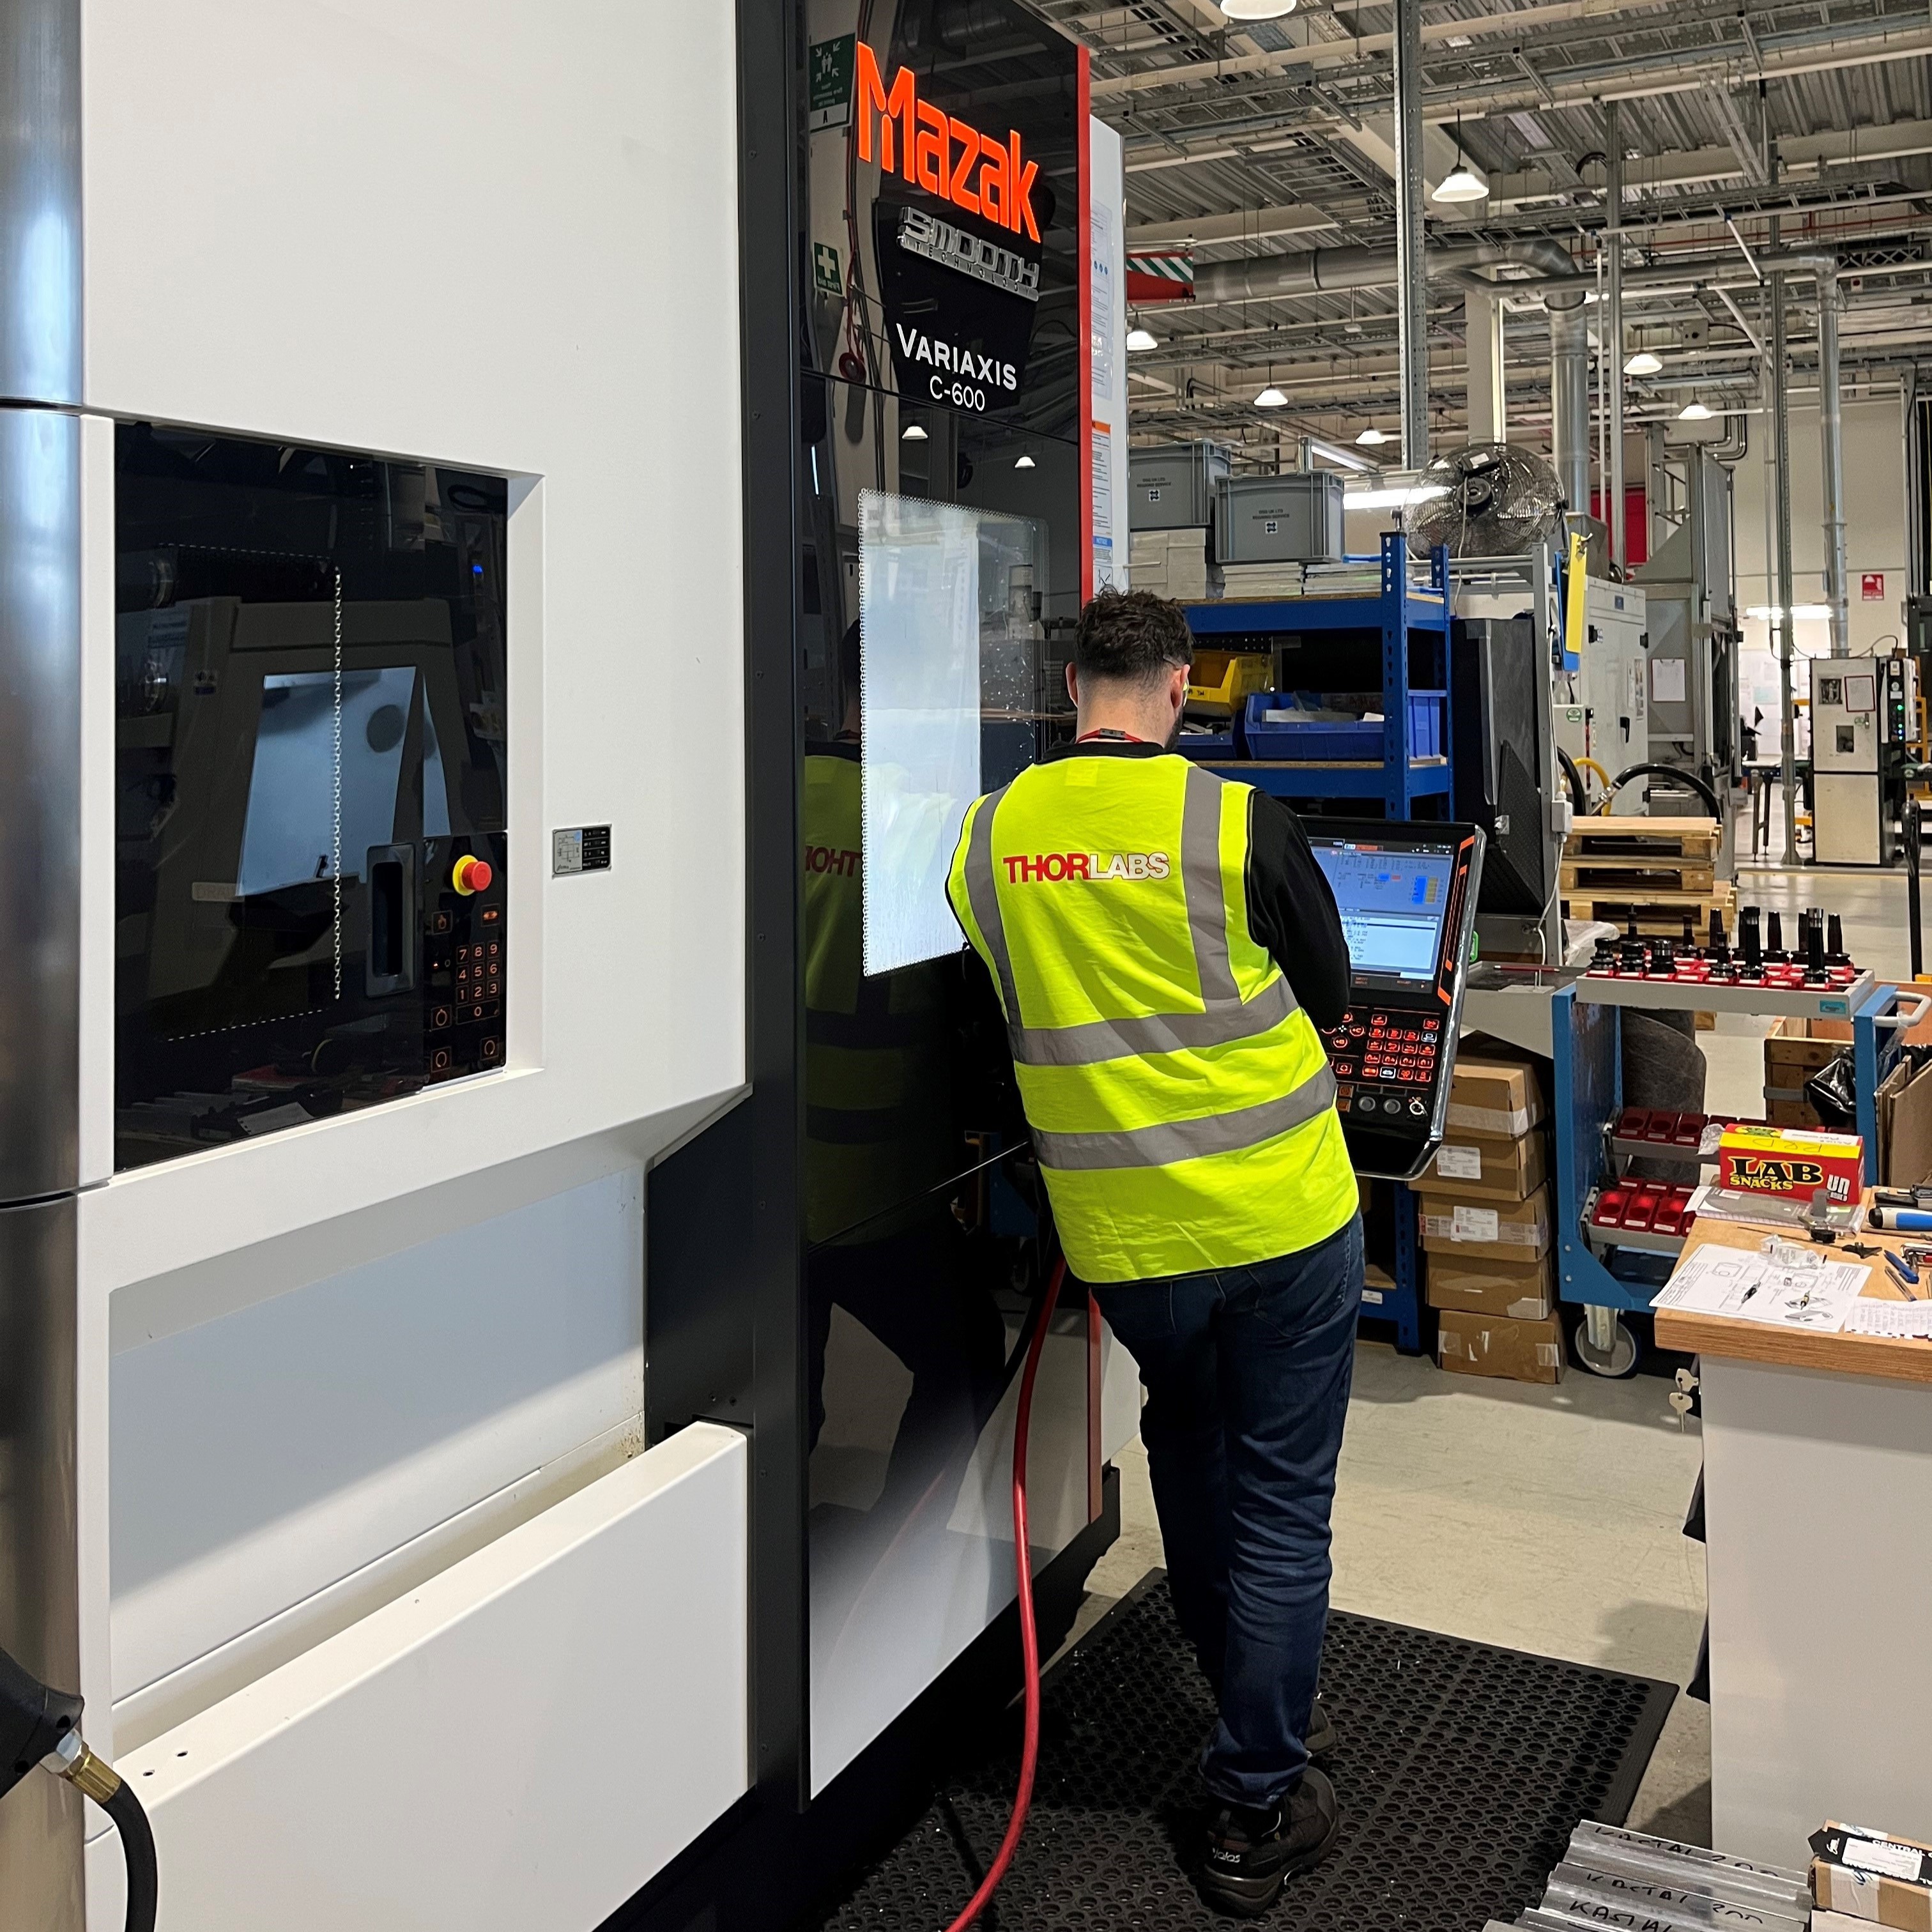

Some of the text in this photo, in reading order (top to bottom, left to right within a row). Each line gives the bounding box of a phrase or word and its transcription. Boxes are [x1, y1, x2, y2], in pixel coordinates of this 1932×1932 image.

[857, 40, 1041, 243] Mazak
[897, 206, 1040, 289] SMOOTH
[914, 240, 1031, 296] TECHNOLOGY
[896, 323, 1017, 390] VARIAXIS
[930, 375, 985, 411] C-600
[1002, 852, 1170, 884] THORLABS
[459, 944, 498, 960] 7 8 9
[459, 963, 498, 979] 4 5 6
[474, 986, 482, 997] 2
[489, 983, 498, 993] 3
[474, 1006, 482, 1016] 0
[1727, 1156, 1824, 1185] LAB
[1729, 1174, 1794, 1191] SNACKS
